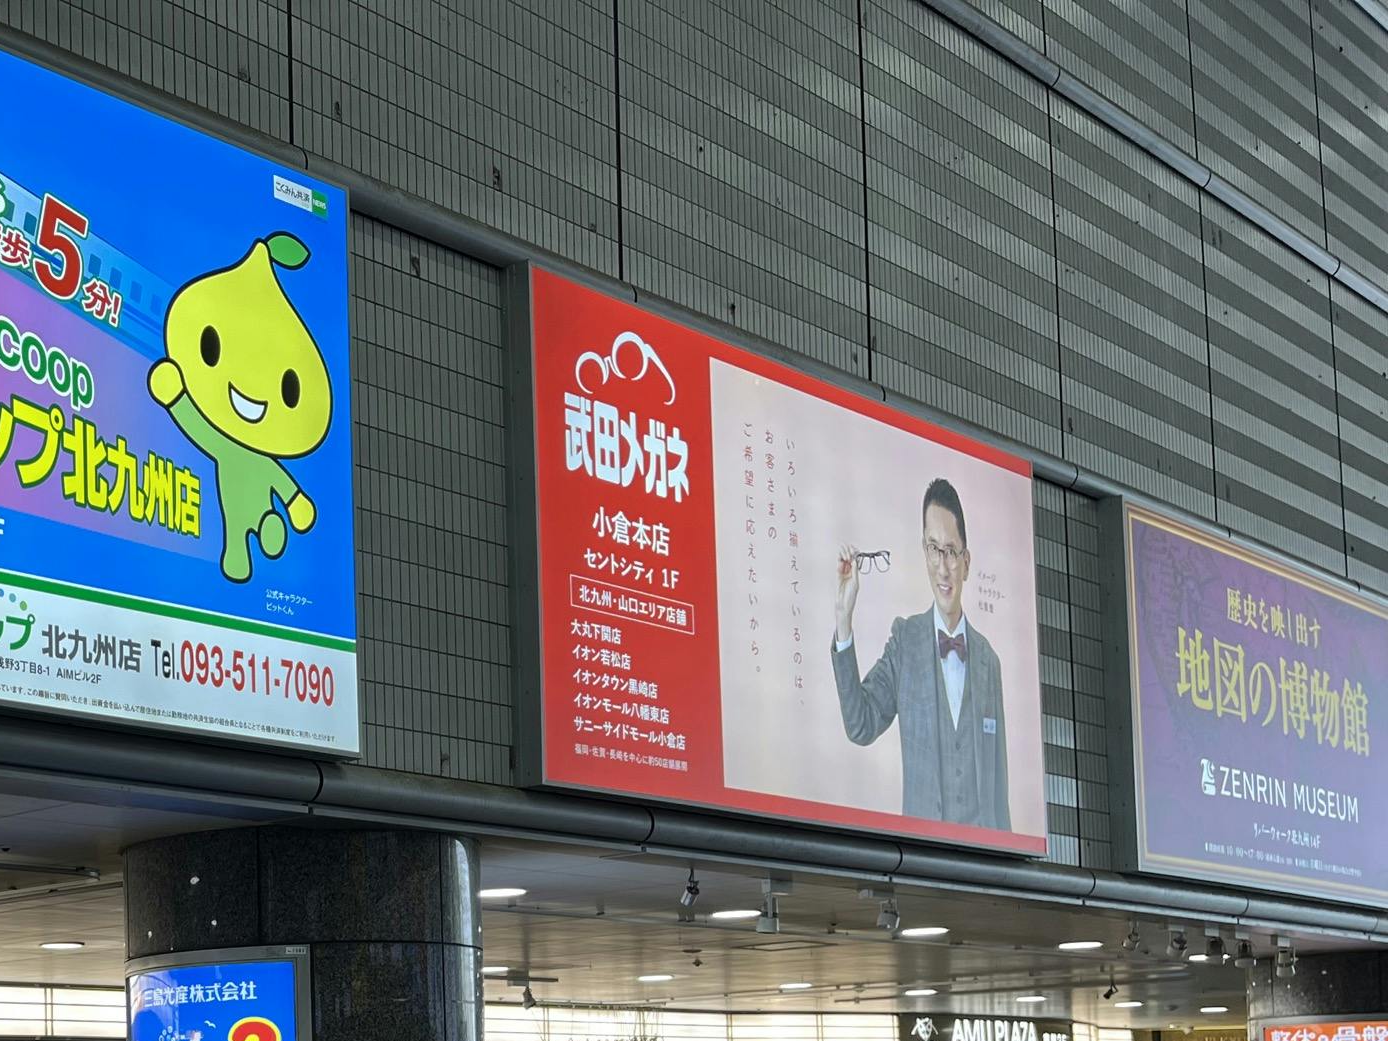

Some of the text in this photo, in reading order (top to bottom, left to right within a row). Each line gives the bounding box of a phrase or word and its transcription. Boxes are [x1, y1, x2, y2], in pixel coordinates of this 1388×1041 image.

[563, 391, 690, 504] 武田メガネ
[764, 429, 779, 541] お客さまの
[592, 506, 671, 557] 小倉本店
[583, 547, 681, 590] セントシティ 1F
[577, 583, 688, 627] 北九州・山口エリア店舗
[1225, 586, 1322, 650] 歴史を映し出す
[41, 623, 142, 674] 北九州店
[570, 618, 623, 645] 大丸下関店
[56, 668, 103, 685] AIMビル2F
[572, 643, 632, 671] イオン若松店
[572, 668, 659, 700] イオンタウン黒崎店
[1176, 625, 1371, 758] 地図の博物館
[573, 692, 671, 725] イオンモール八幡東店
[573, 716, 687, 751] サニーサイドモール小倉店
[1219, 765, 1360, 824] ZENRIN MUSEUM
[143, 981, 258, 1008] 三島光産株式会社
